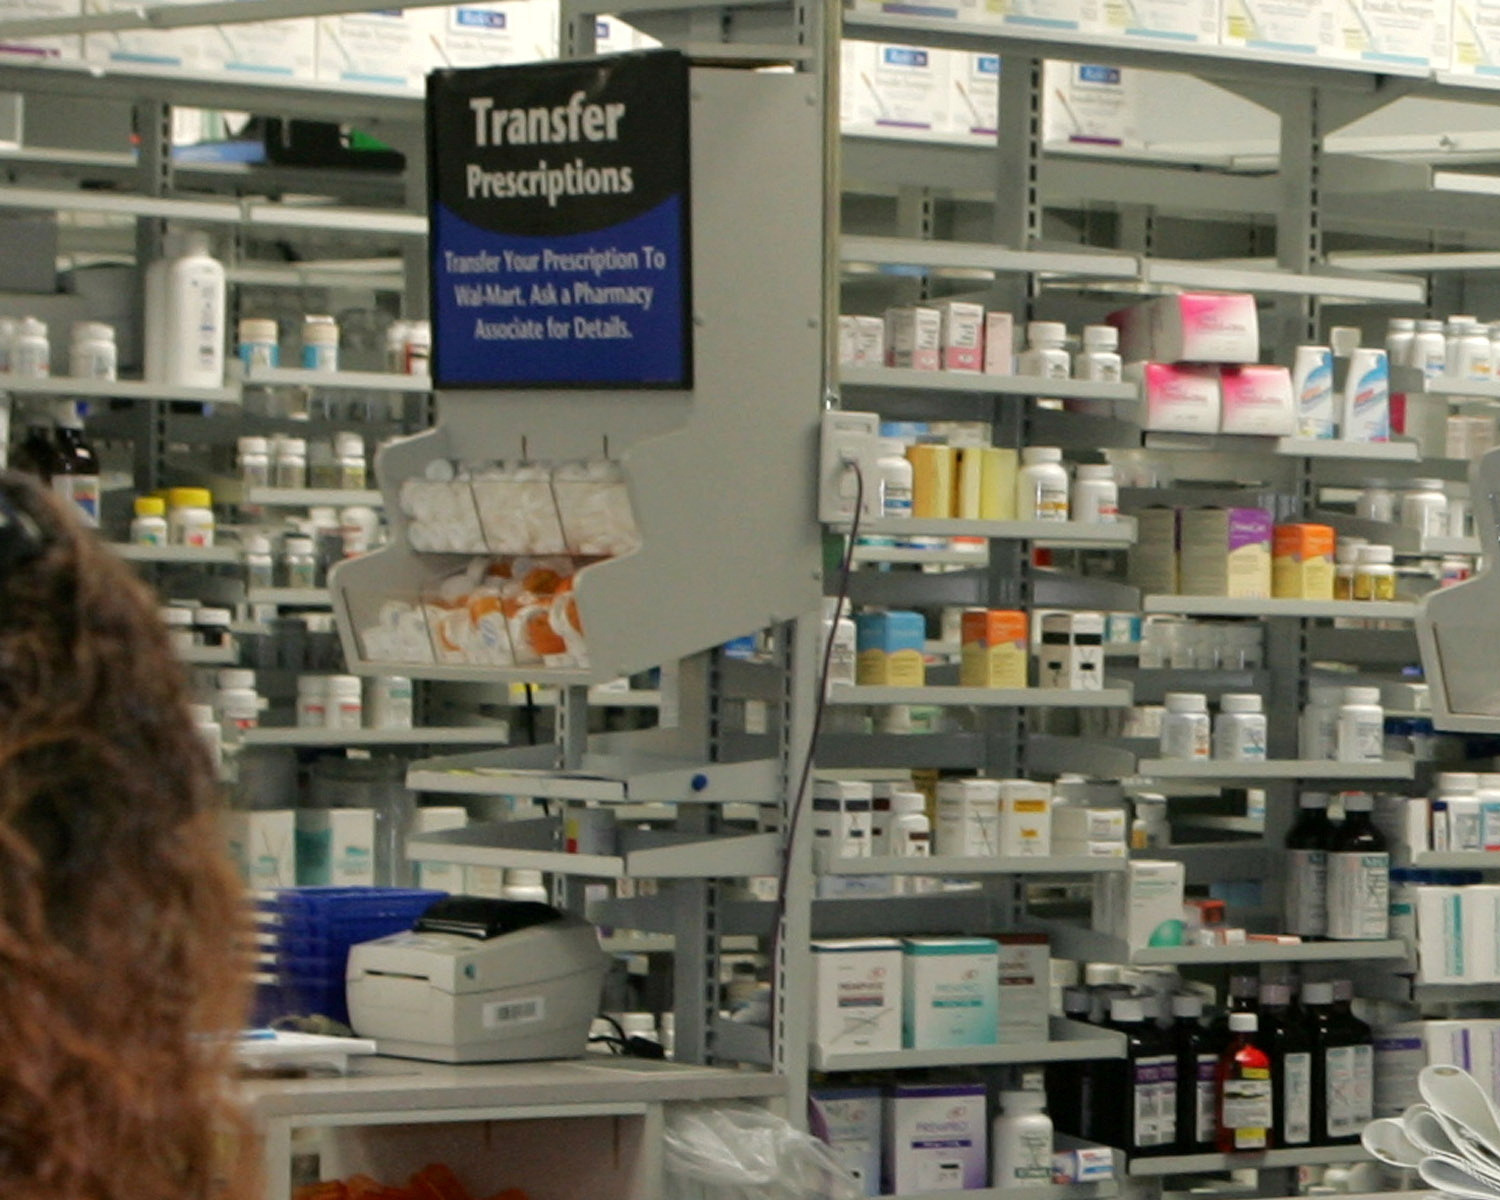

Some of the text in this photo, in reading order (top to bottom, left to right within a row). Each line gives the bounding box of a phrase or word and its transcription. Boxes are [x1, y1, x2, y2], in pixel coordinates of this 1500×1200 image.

[469, 90, 625, 147] Transfer
[466, 158, 634, 208] Prescriptions
[444, 246, 667, 276] Transfer Your Prescription To
[454, 282, 655, 311] Wal-Mart. Ask a Pharmacy
[475, 316, 633, 340] Associate for Details.
